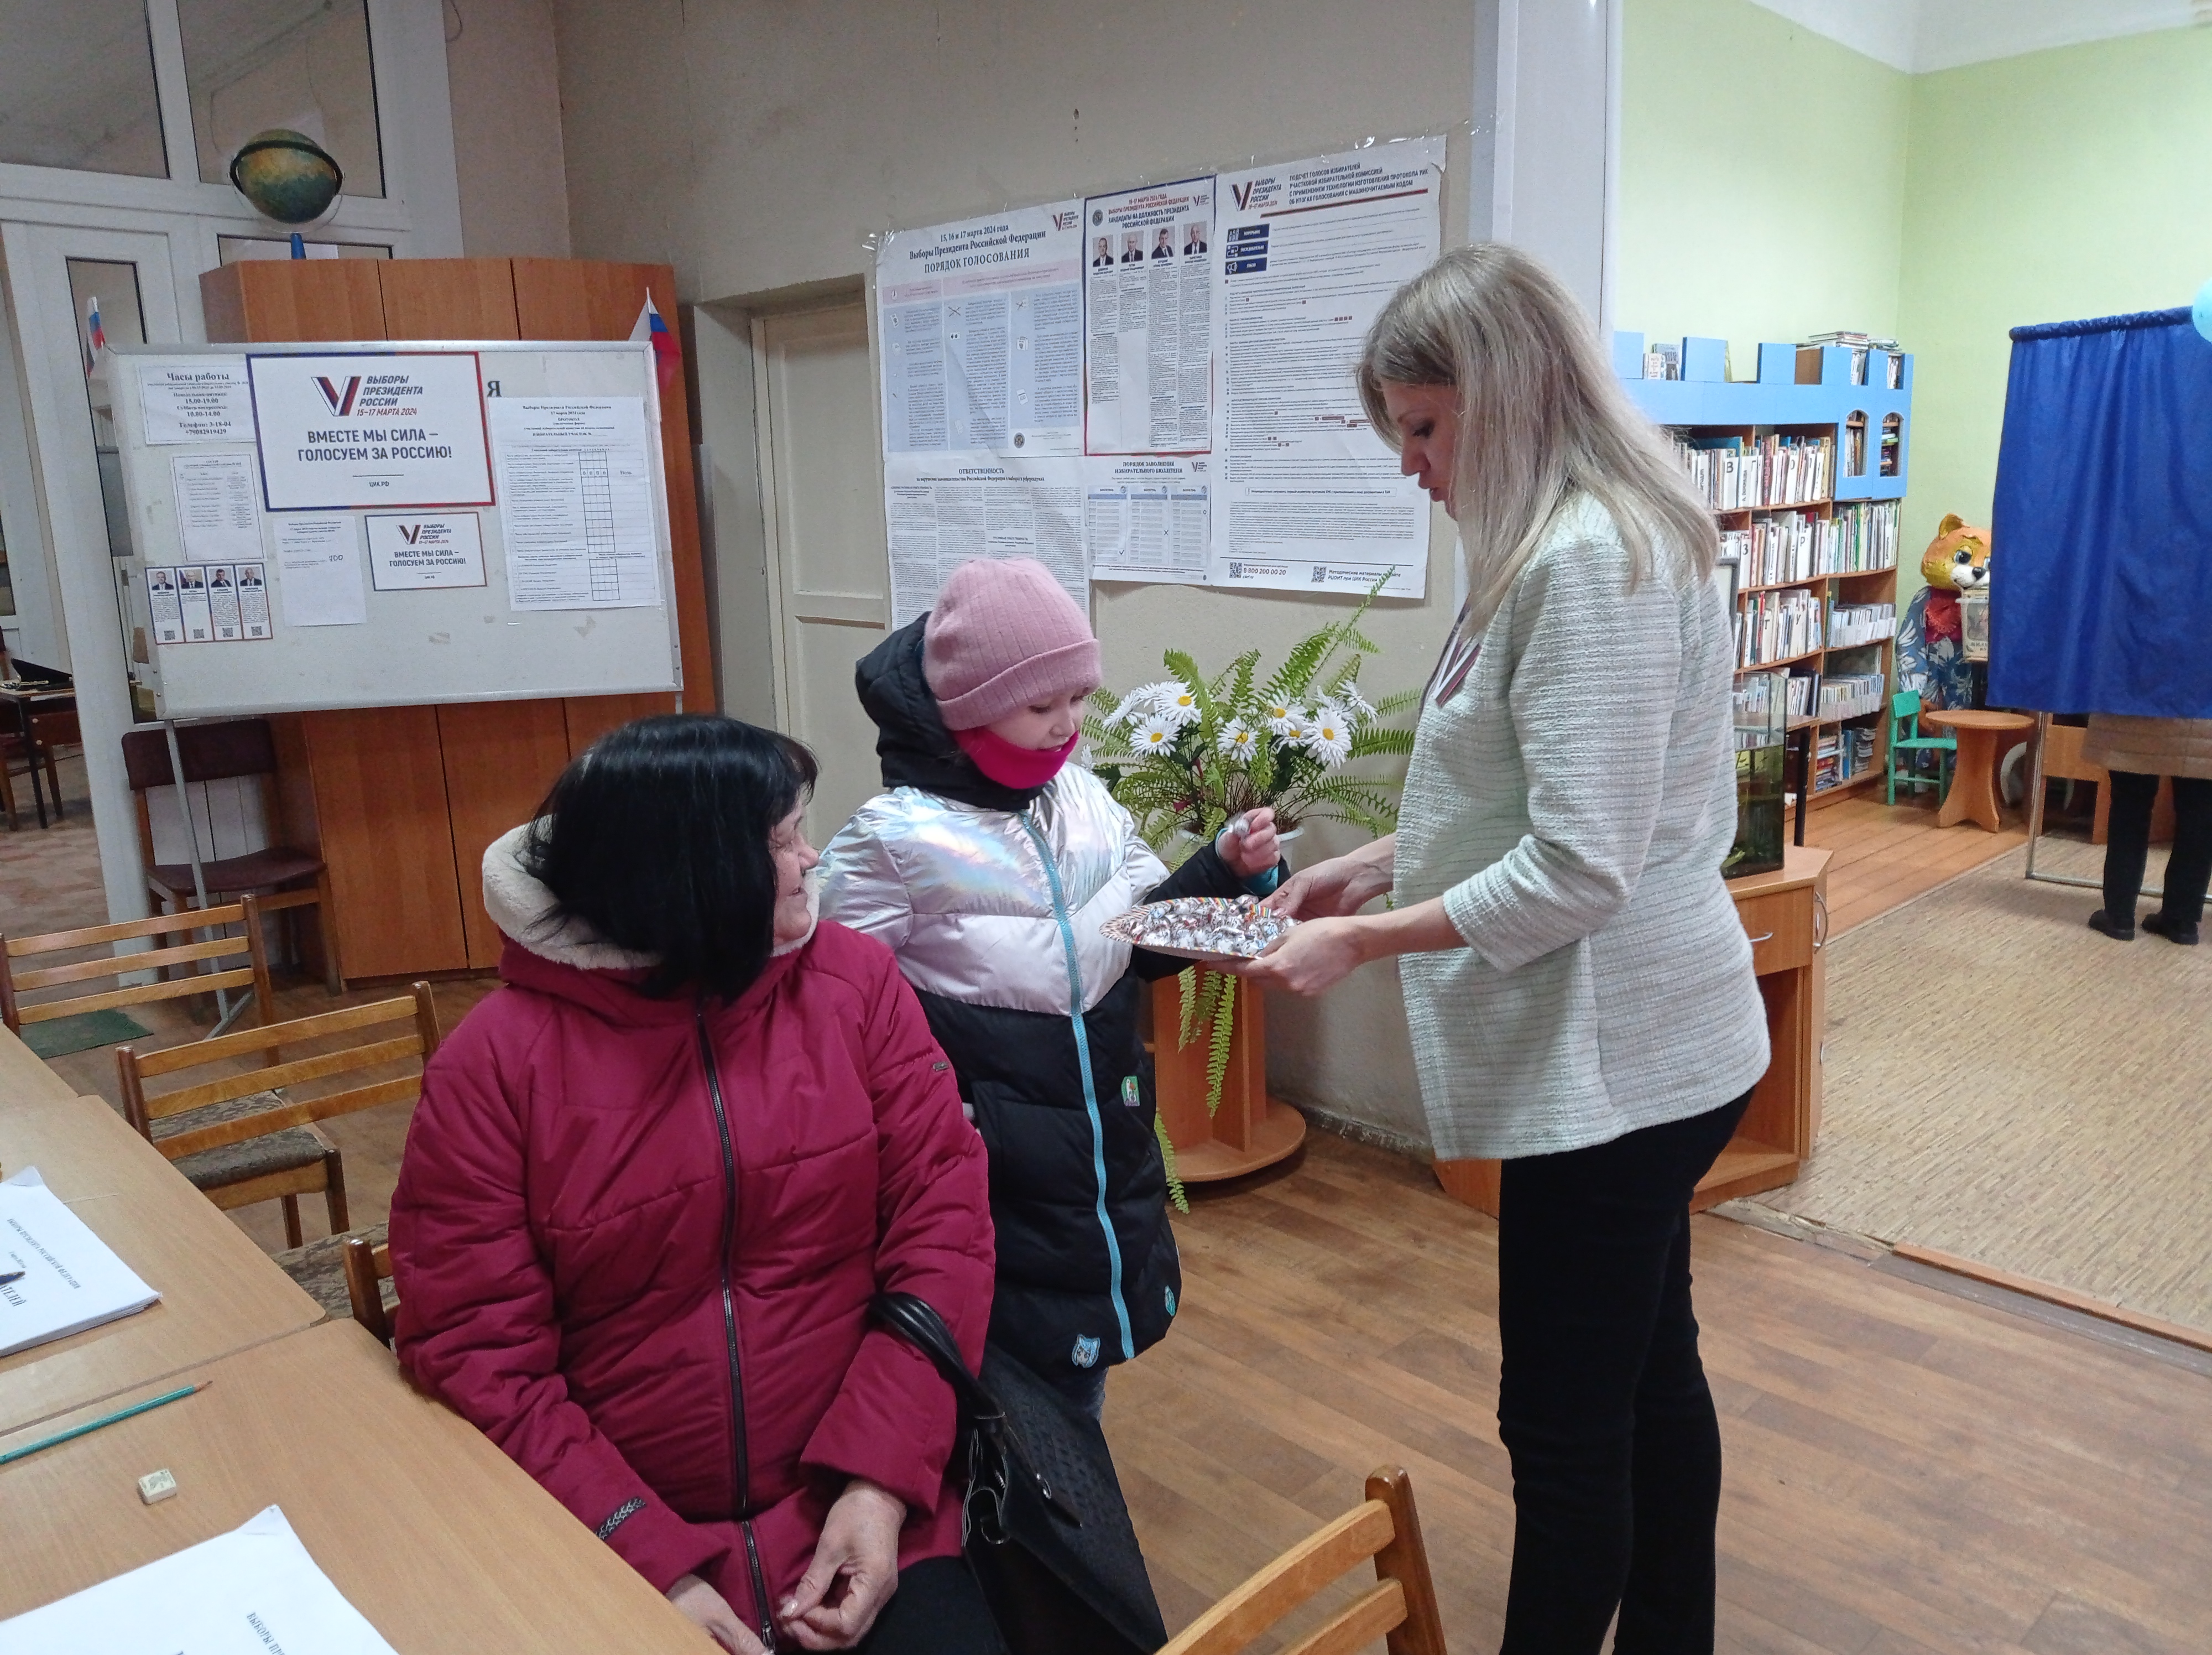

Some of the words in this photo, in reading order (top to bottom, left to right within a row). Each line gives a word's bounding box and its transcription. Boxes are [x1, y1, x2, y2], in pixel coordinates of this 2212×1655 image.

[1309, 169, 1329, 179] ГОЛОСОВ
[1330, 162, 1360, 175] ИЗБИРАТЕЛЕЙ
[1255, 177, 1276, 188] ВЫБОРЫ
[1290, 178, 1317, 189] УЧАСТКОВОЙ
[1318, 172, 1355, 185] ИЗБИРАТЕЛЬНОЙ
[1355, 166, 1383, 179] КОМИССИЕЙ
[1293, 186, 1325, 196] ПРИМЕНЕНИЕМ
[1326, 181, 1354, 192] ТЕХНОЛОГИИ
[1355, 175, 1390, 186] ИЗГОТОВЛЕНИЯ
[1390, 170, 1418, 181] ПРОТОКОЛА
[1253, 184, 1282, 195] ПРЕЗИДЕНТА
[1296, 195, 1312, 204] ИТОГАХ
[1313, 191, 1344, 202] ГОЛОСОВАНИЯ
[1349, 183, 1395, 196] МАШИНОЧИТАЕМЫМ
[1396, 179, 1413, 188] КОДОМ
[1250, 194, 1270, 203] РОССИИ
[1123, 204, 1145, 212] ПРЕЗИДЕНТА
[1145, 199, 1167, 209] РОССИЙСКОЙ
[1108, 214, 1132, 223] КАНДИДАТЫ
[1139, 210, 1164, 219] ДОЛЖНОСТЬ
[1164, 205, 1190, 215] ПРЕЗИДЕНТА
[1122, 219, 1149, 229] РОССИЙСКОЙ
[1149, 216, 1175, 226] ФЕДЕРАЦИИ
[967, 229, 983, 238] марта
[984, 226, 996, 235] 2024
[997, 225, 1009, 233] года
[910, 247, 933, 260] Выборы
[935, 243, 968, 257] Президента
[970, 235, 1008, 249] Российской
[1009, 231, 1046, 244] Федерации
[925, 258, 961, 273] ПОРЯДОК
[963, 248, 1030, 267] ГОЛОСОВАНИЯ
[167, 373, 192, 381] Часы
[195, 373, 229, 382] работы
[367, 376, 409, 384] ВЫБОРЫ
[363, 387, 423, 396] ПРЕЗИДЕНТА
[487, 381, 502, 397] Я
[359, 398, 398, 407] РОССИИ
[376, 408, 399, 416] МАРТА
[307, 430, 359, 443] ВМЕСТЕ
[363, 429, 387, 442] МЫ
[391, 429, 426, 441] СИЛА
[298, 447, 368, 461] ГОЛОСУЕМ
[372, 447, 388, 460] ЗА
[392, 446, 452, 459] РОССИЮ!
[389, 559, 424, 567] ГОЛОСУЕМ
[247, 1612, 274, 1644] ВЫБОРЫ
